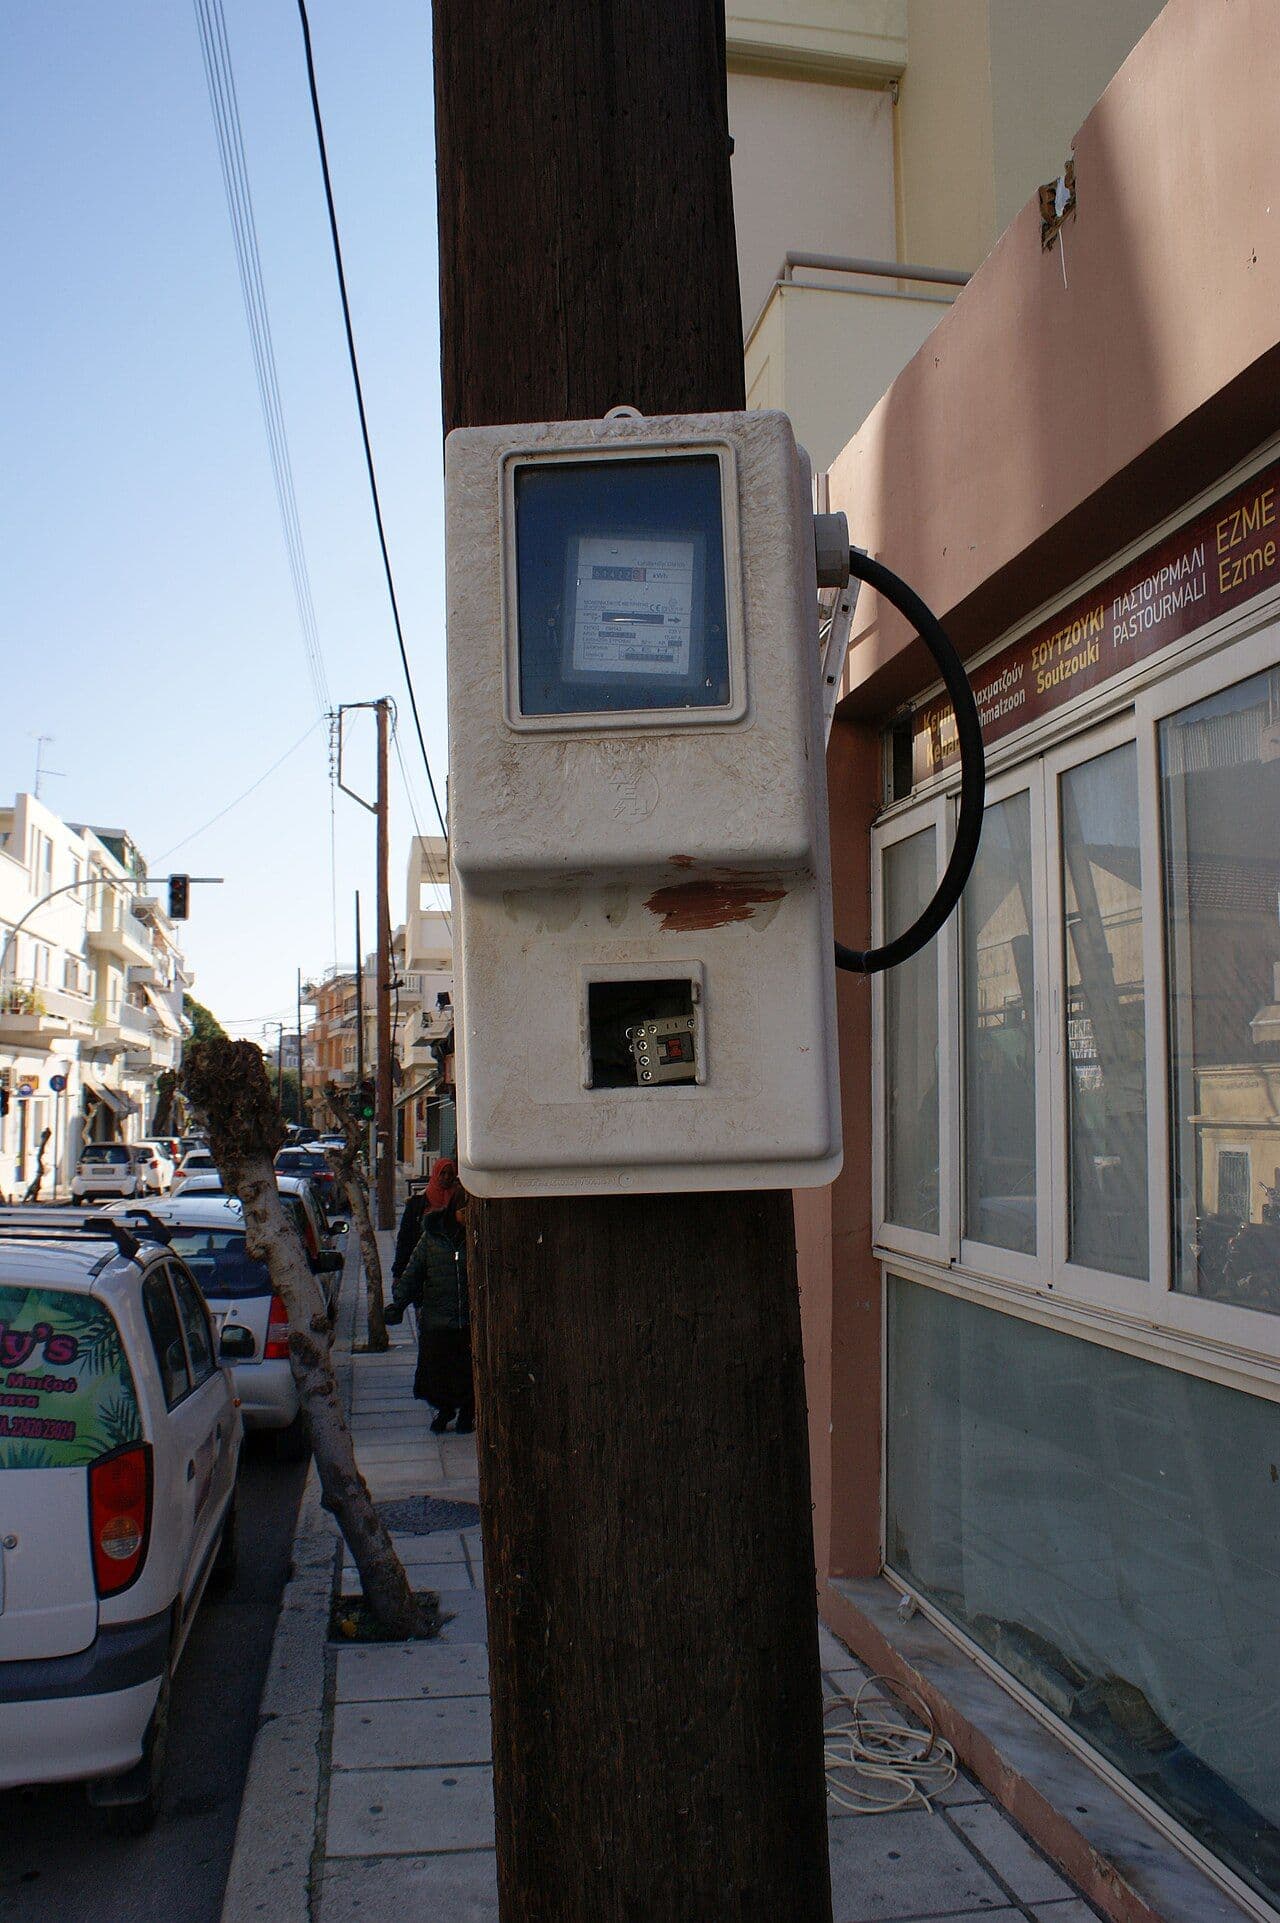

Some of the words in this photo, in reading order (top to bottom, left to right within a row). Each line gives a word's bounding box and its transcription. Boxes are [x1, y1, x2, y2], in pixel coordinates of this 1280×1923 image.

[1112, 542, 1205, 620] ΠΑΣΤΟΥΡΜΑΛΙ
[1218, 540, 1276, 594] Ezme
[1031, 604, 1105, 672] ΣΟΥΤΖΟΥΚΙ
[1112, 572, 1207, 648] PASTOURMALI
[1036, 637, 1100, 694] Soutzouki
[978, 688, 1026, 728] hmatzoon
[926, 738, 960, 768] Keba
